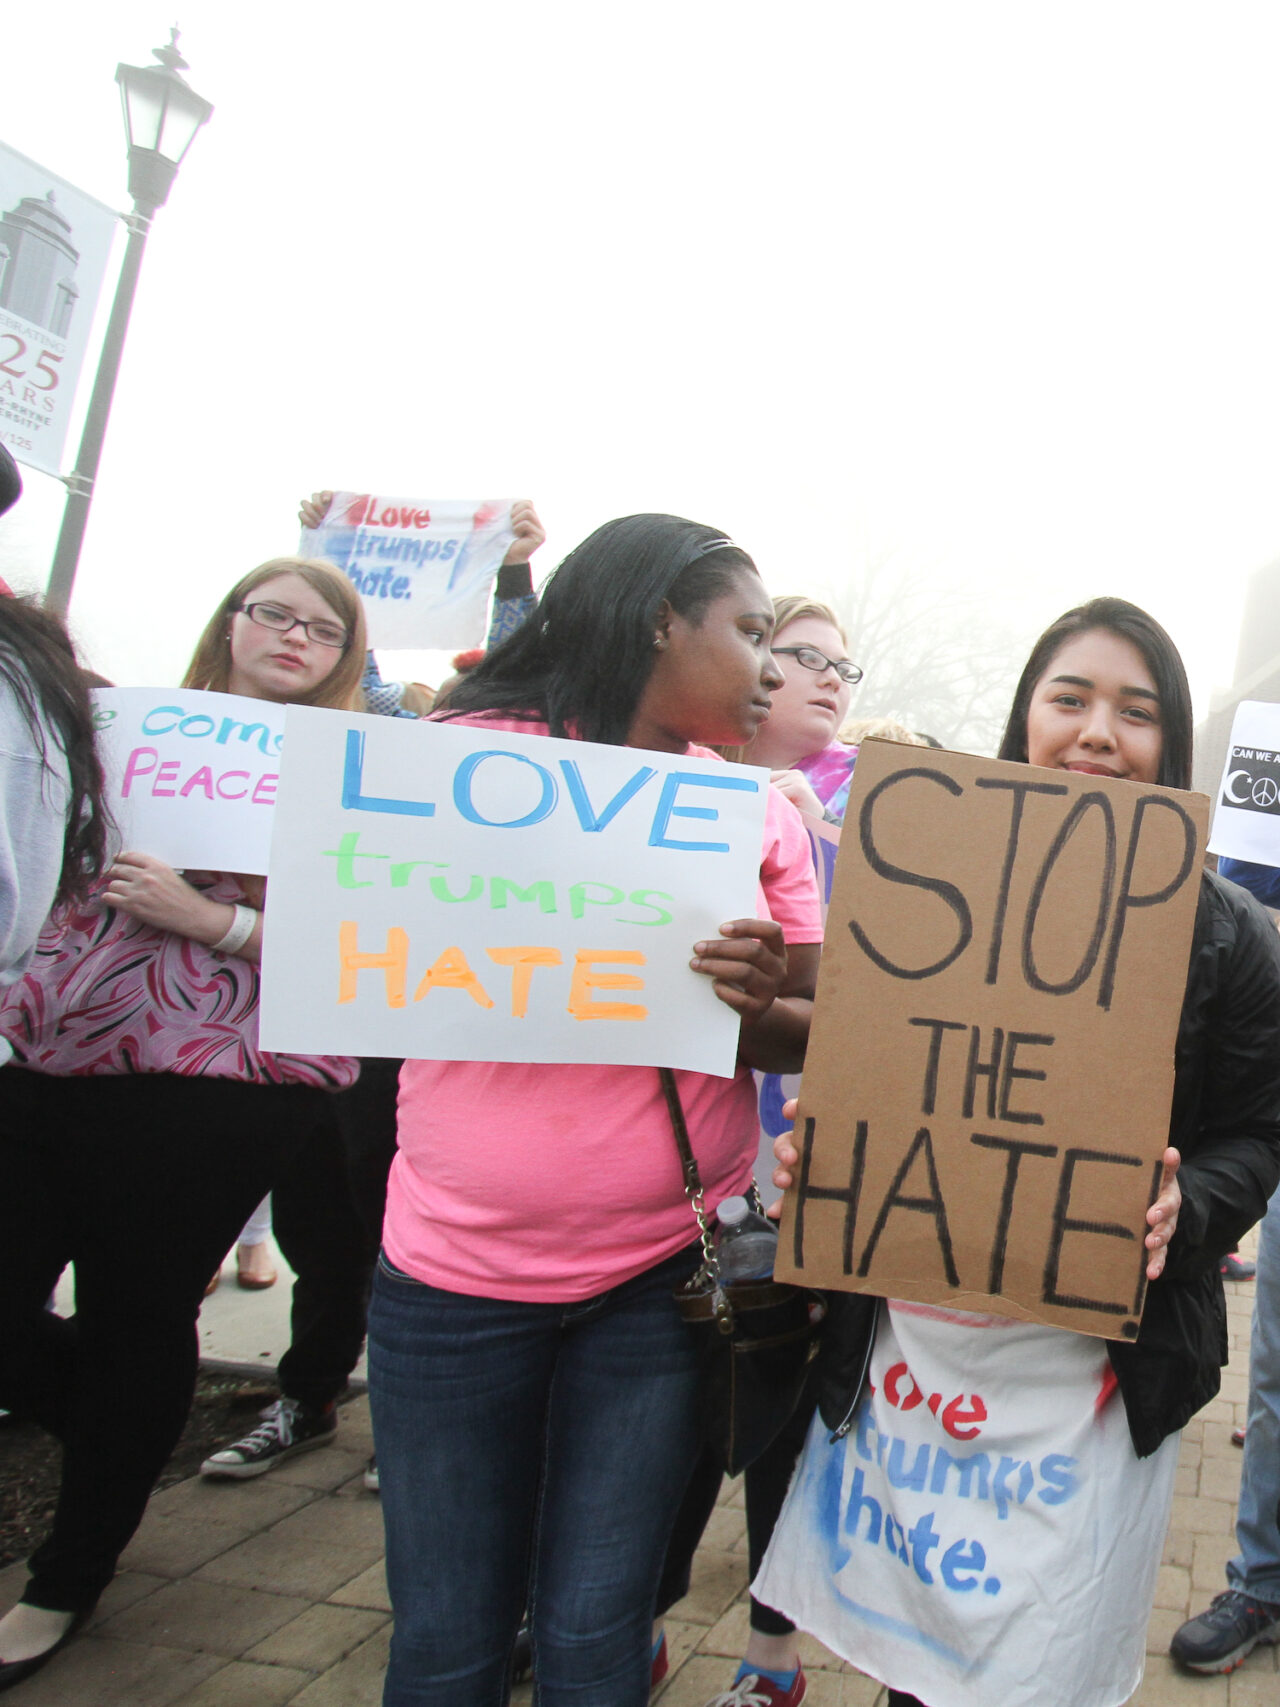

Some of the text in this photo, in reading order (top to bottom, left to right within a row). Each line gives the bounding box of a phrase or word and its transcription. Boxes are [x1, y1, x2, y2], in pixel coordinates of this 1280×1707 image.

[355, 529, 458, 568] trumps
[364, 498, 431, 529] Love
[120, 746, 279, 805] PEACE
[341, 729, 759, 853] LOVE
[1231, 747, 1254, 759] CAN
[1256, 751, 1272, 762] WE
[848, 766, 1196, 1011] STOP
[336, 920, 649, 1022] HATE
[908, 1017, 1055, 1125] THE
[844, 1466, 1002, 1596] hate.
